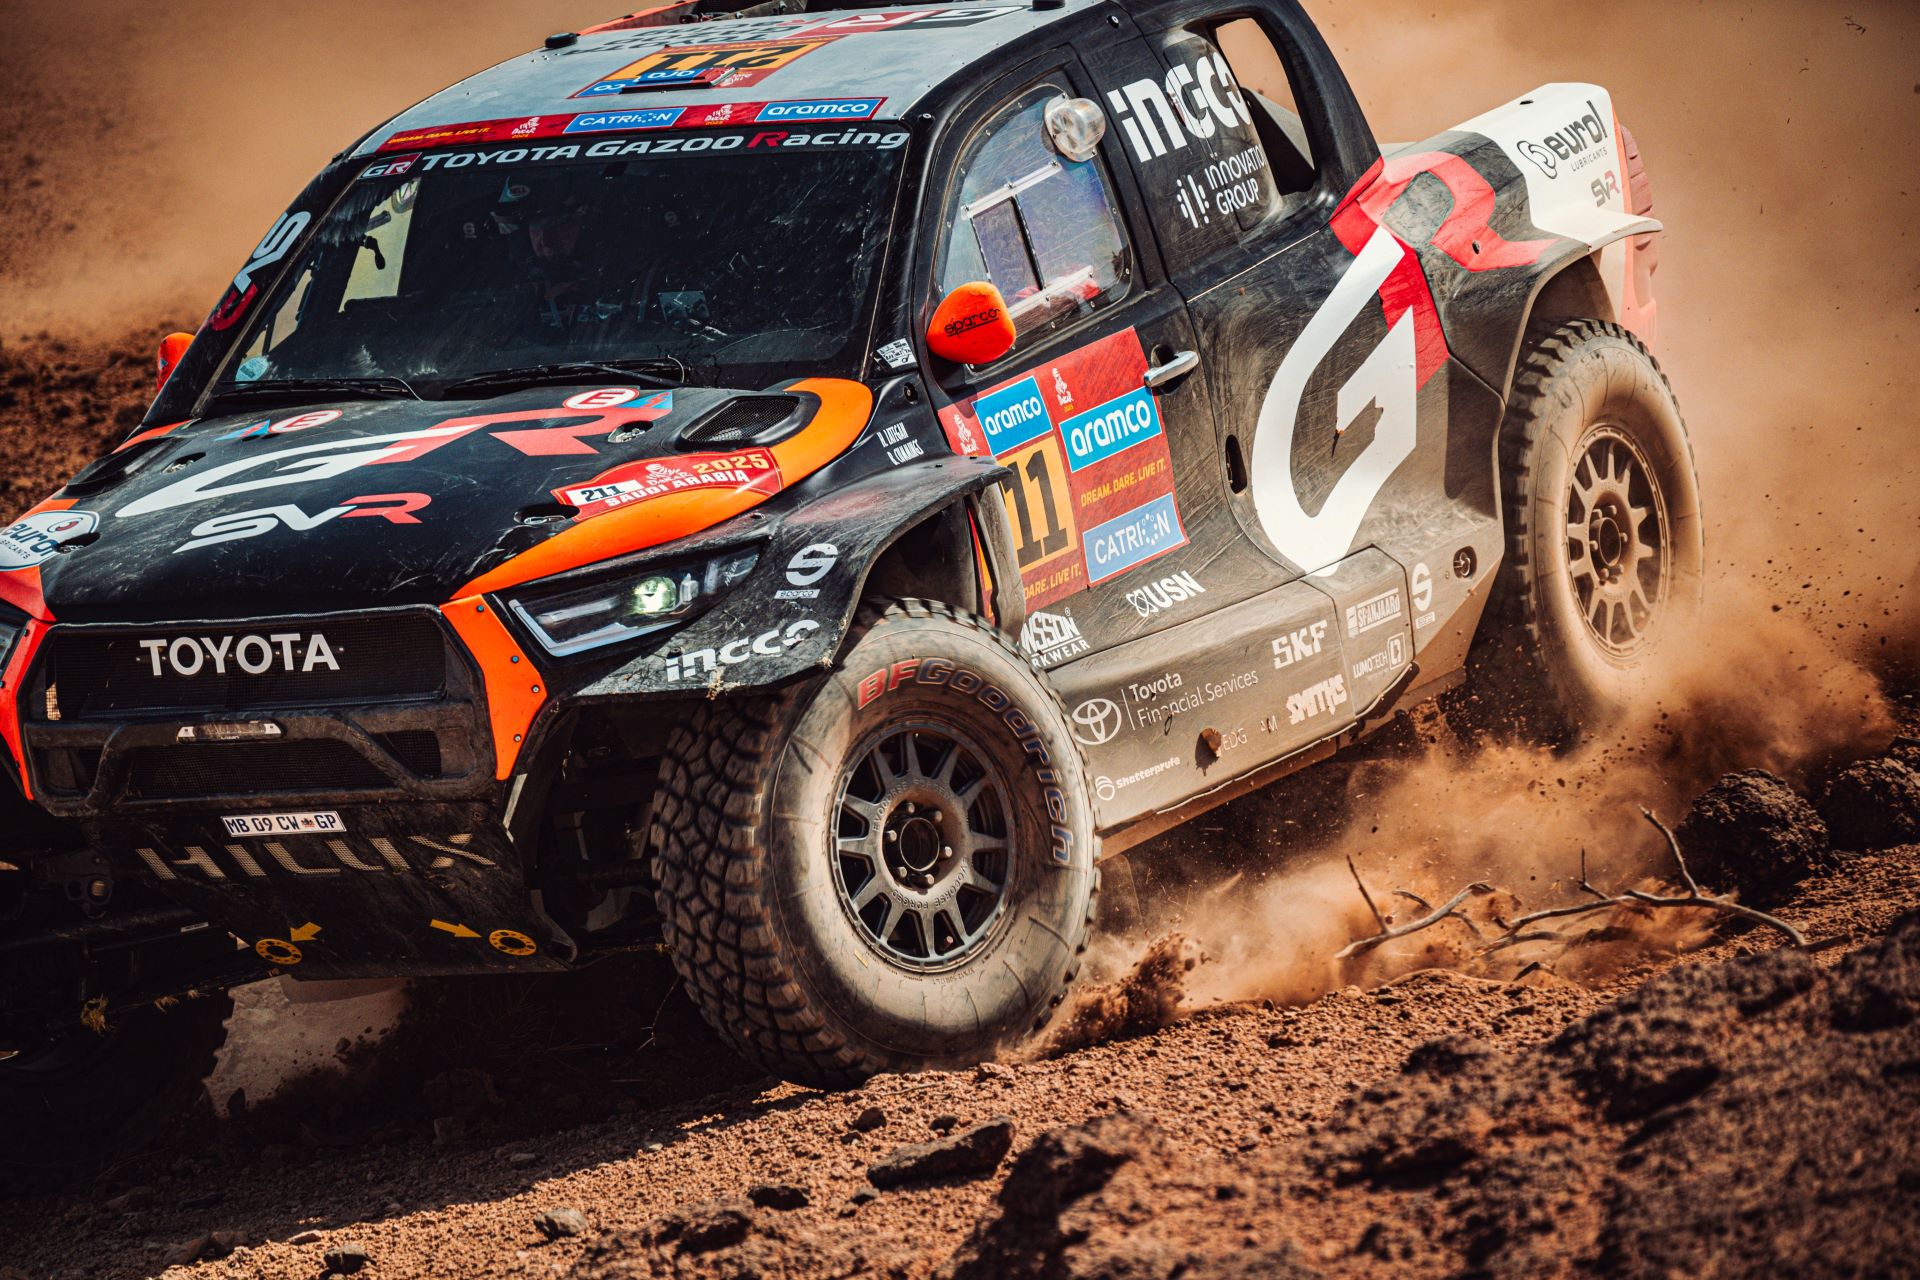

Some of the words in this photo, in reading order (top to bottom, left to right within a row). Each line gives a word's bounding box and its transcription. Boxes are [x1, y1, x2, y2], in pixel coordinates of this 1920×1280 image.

[767, 103, 868, 116] aramco
[1543, 100, 1608, 161] eurol
[421, 149, 574, 171] TOYOTA
[585, 135, 744, 157] GAZOO
[746, 128, 911, 149] Racing
[362, 161, 412, 178] GR
[1216, 178, 1260, 214] GROUP
[944, 307, 1001, 337] sparco
[985, 396, 1042, 436] aramco
[1071, 399, 1151, 457] aramco
[692, 453, 770, 473] 2025
[581, 485, 624, 502] 211
[605, 485, 670, 507] SAUDI
[674, 469, 751, 489] ARABIA
[1080, 483, 1112, 508] DREAM.
[1113, 472, 1137, 493] DARE.
[1138, 462, 1156, 481] LIVE
[1156, 457, 1166, 473] IT.
[1050, 569, 1070, 589] LIVE
[1071, 563, 1082, 579] IT.
[1144, 570, 1206, 611] USN
[139, 633, 341, 676] TOYOTA
[1271, 619, 1328, 669] SKF
[1129, 672, 1183, 702] Toyota
[1205, 670, 1259, 701] Services
[1116, 756, 1181, 789] Shatterprufe
[224, 818, 250, 833] MB
[251, 817, 273, 832] 09
[276, 816, 301, 831] CW
[314, 814, 337, 829] GP
